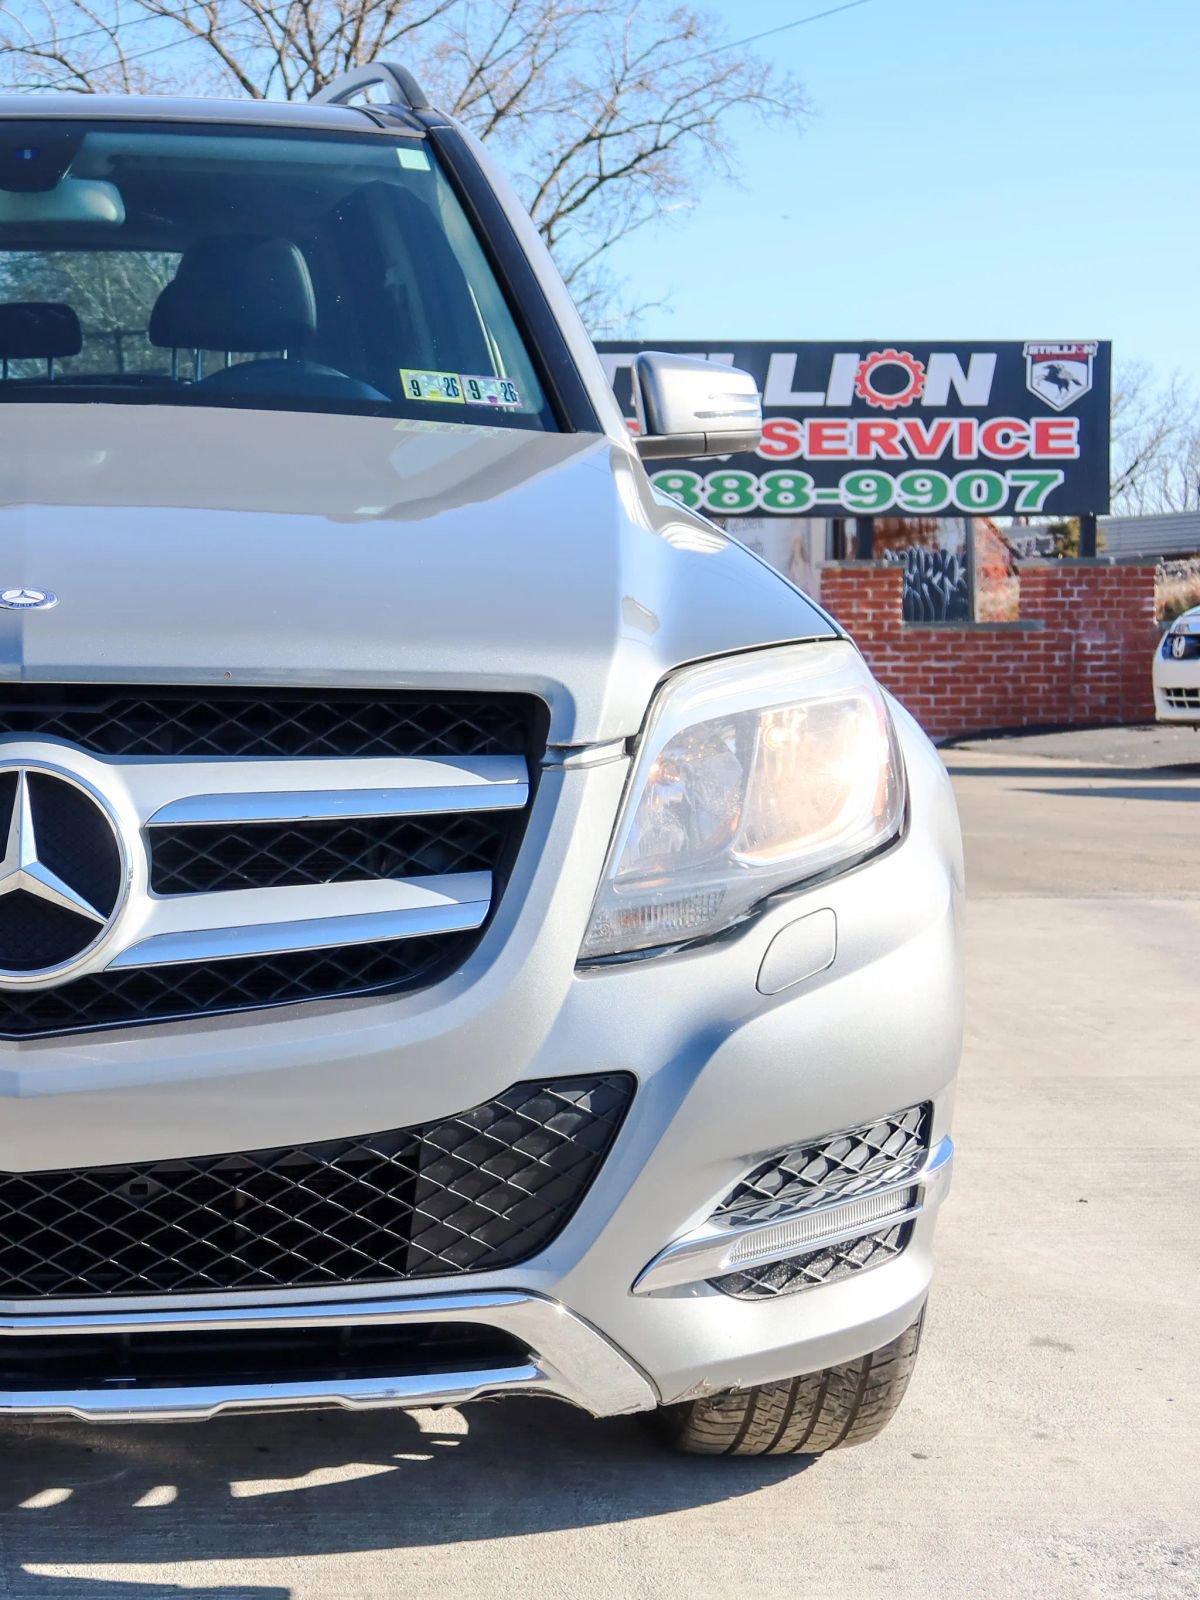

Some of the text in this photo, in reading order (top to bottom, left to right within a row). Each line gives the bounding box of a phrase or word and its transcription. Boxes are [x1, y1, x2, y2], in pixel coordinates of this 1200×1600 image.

[411, 377, 460, 397] 9 26
[469, 379, 517, 401] 9 26
[757, 418, 1079, 460] SERVICE
[650, 469, 1064, 513] 888-9907
